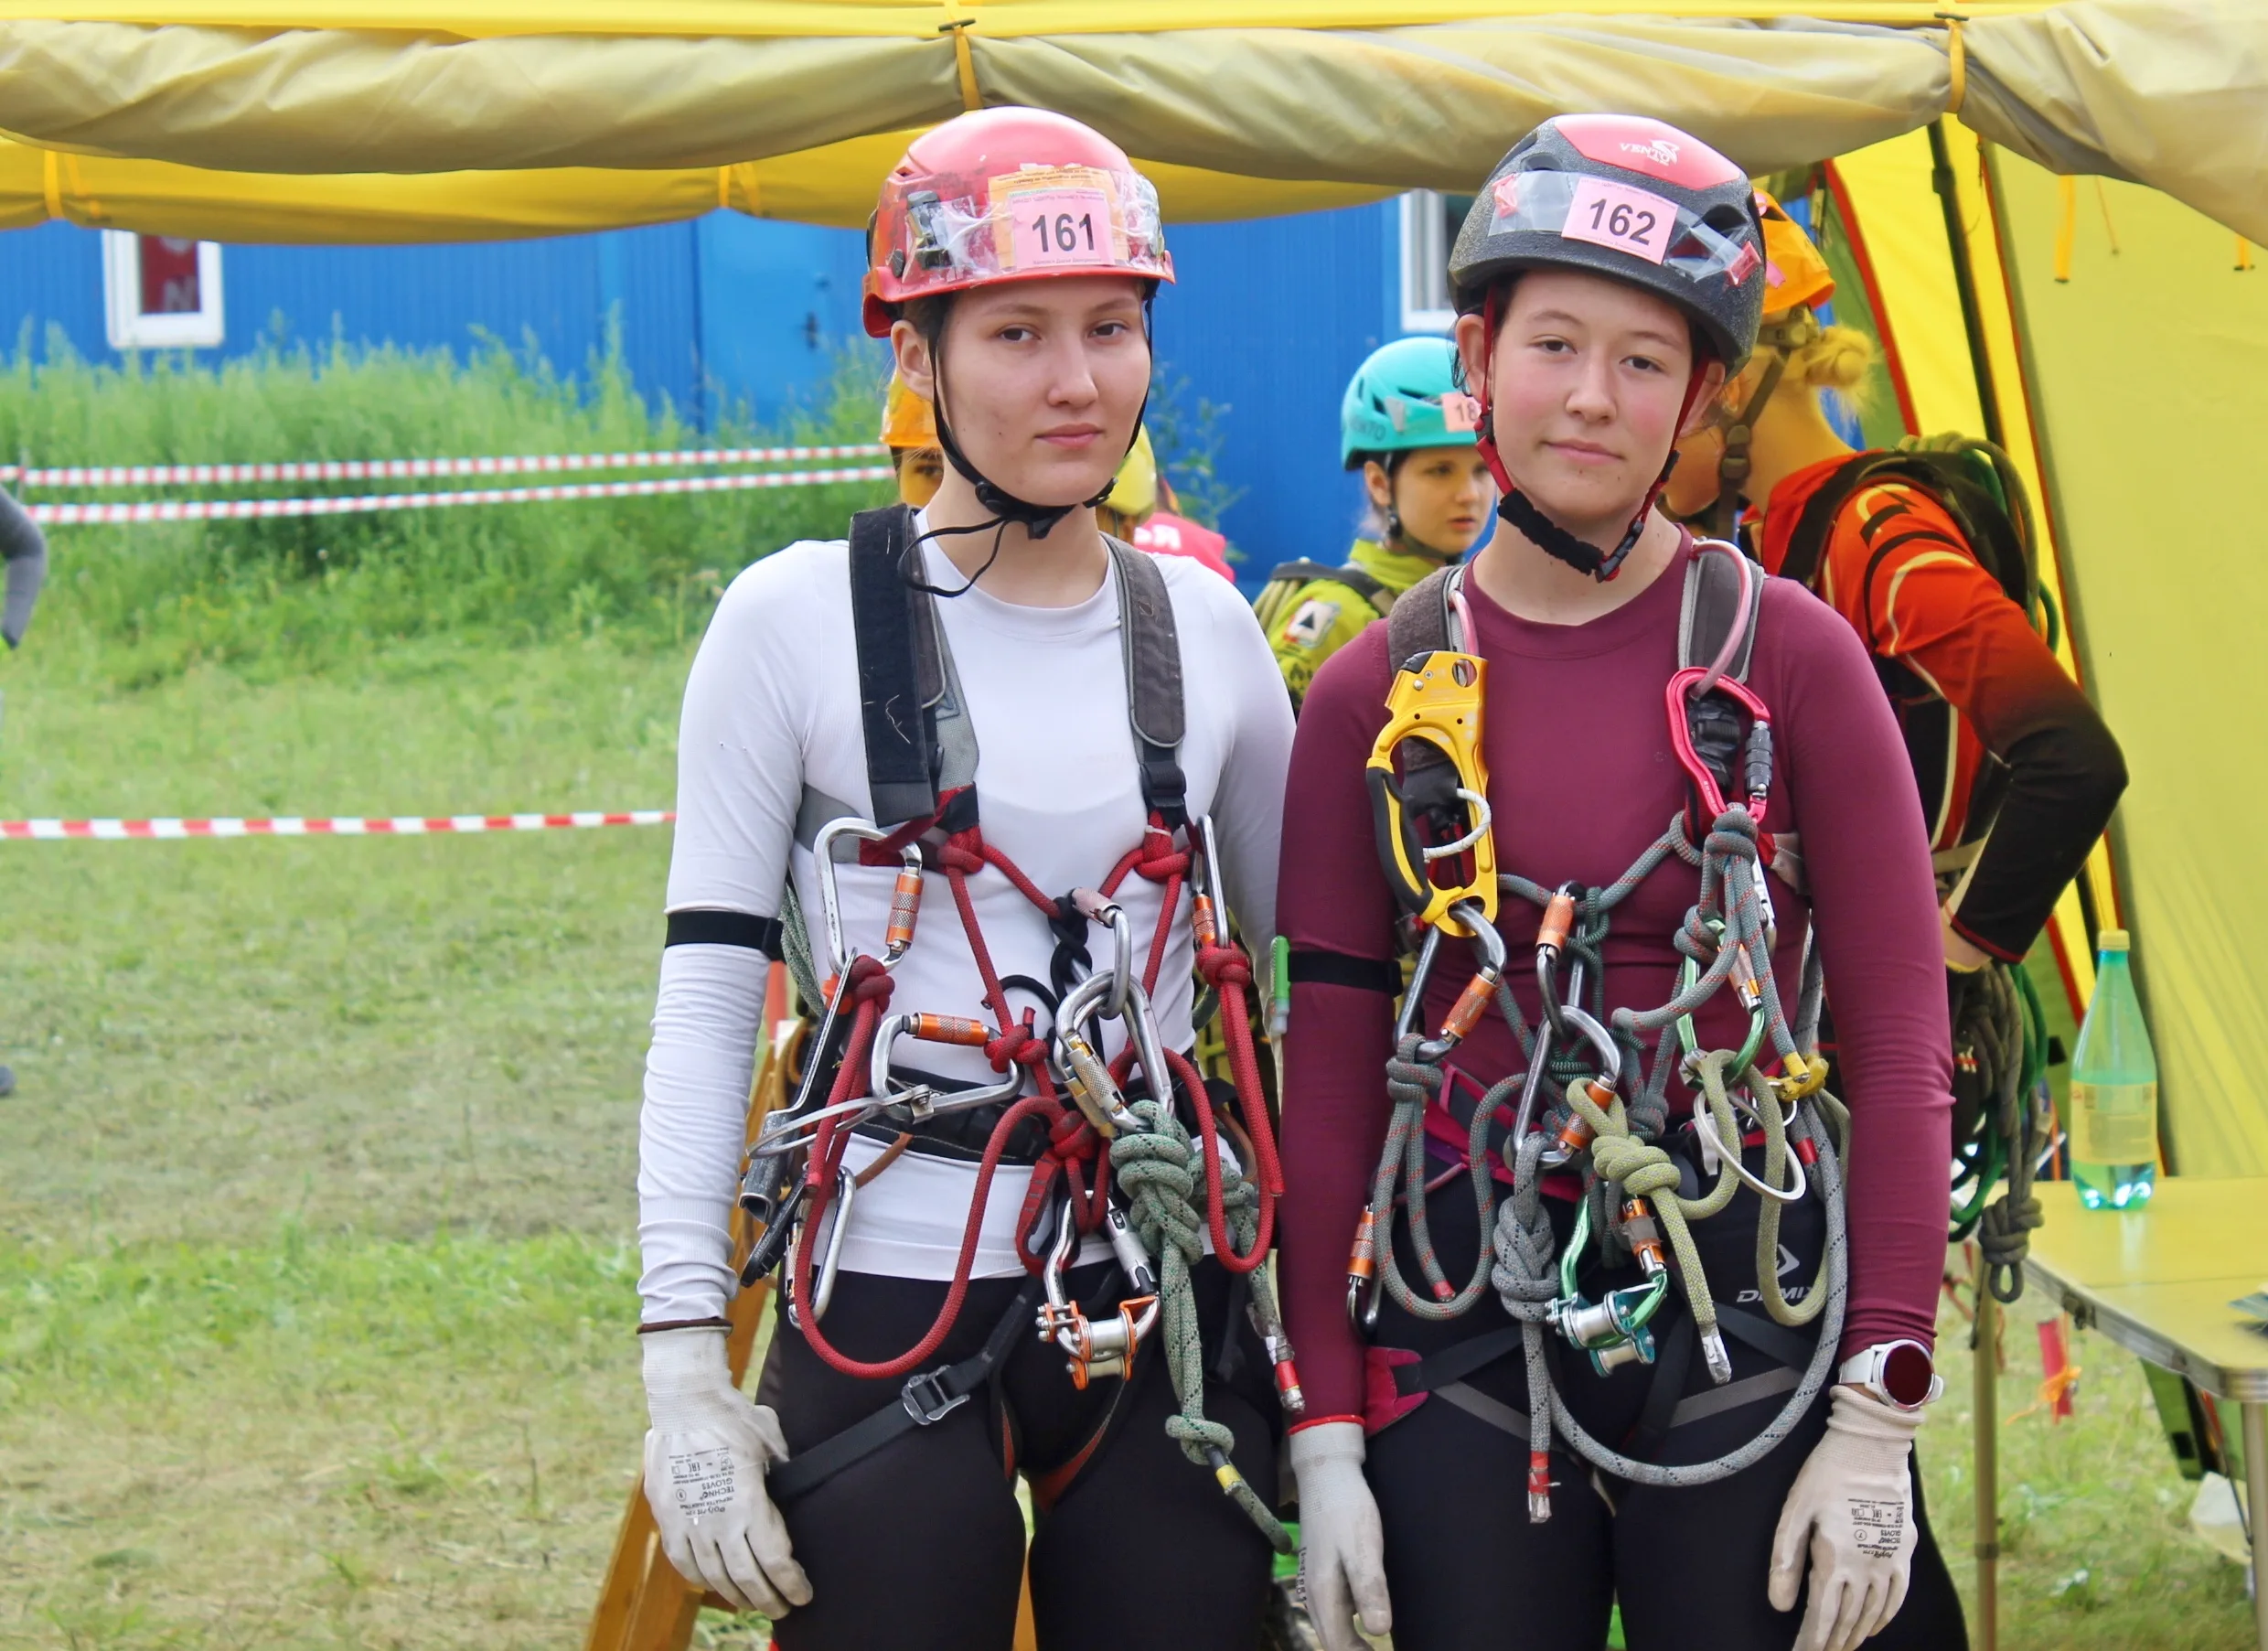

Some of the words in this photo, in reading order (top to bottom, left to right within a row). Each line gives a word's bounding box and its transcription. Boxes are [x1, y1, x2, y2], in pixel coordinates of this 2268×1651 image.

[1620, 143, 1671, 164] VENTO
[1032, 213, 1095, 252] 161
[1589, 198, 1656, 246] 162
[1737, 1286, 1813, 1303] DMI
[701, 1477, 733, 1491] GLOVES
